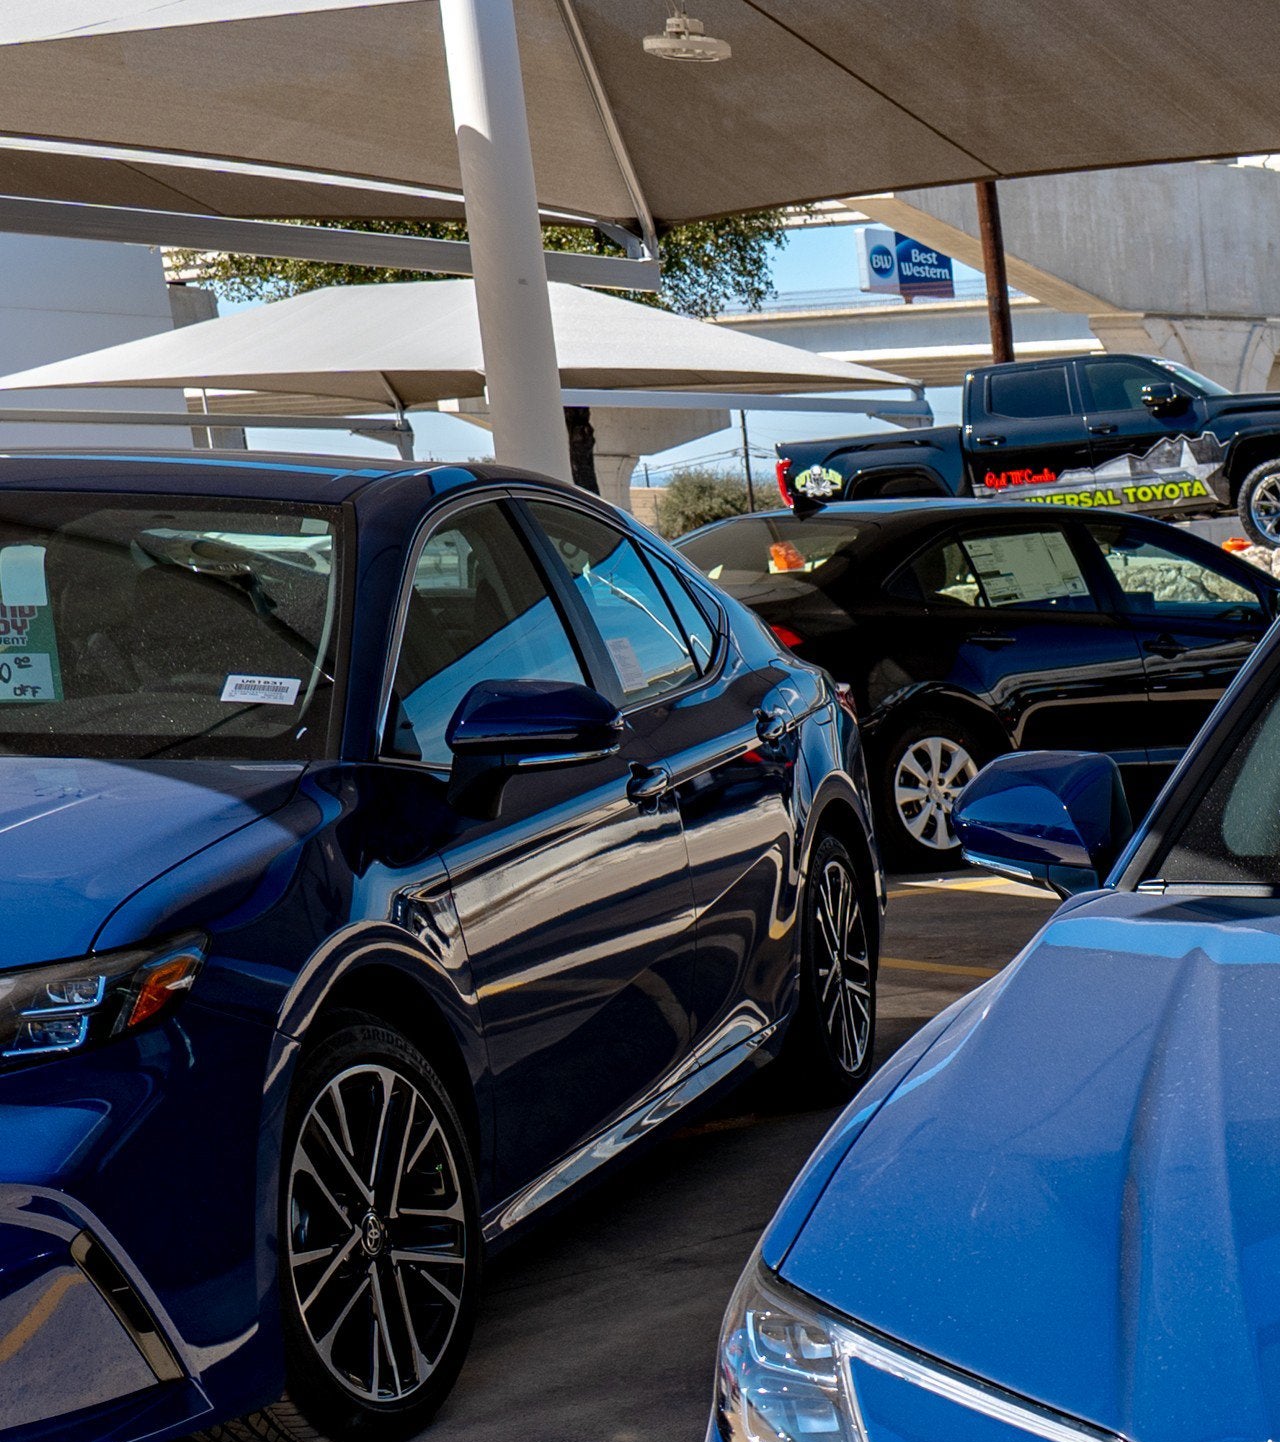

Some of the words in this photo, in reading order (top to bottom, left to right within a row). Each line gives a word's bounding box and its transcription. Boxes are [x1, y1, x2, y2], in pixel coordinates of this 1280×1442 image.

[871, 254, 892, 269] BW
[911, 248, 938, 265] Best
[900, 262, 950, 279] Western
[1123, 479, 1207, 502] TOYOTA
[13, 684, 42, 698] OFF
